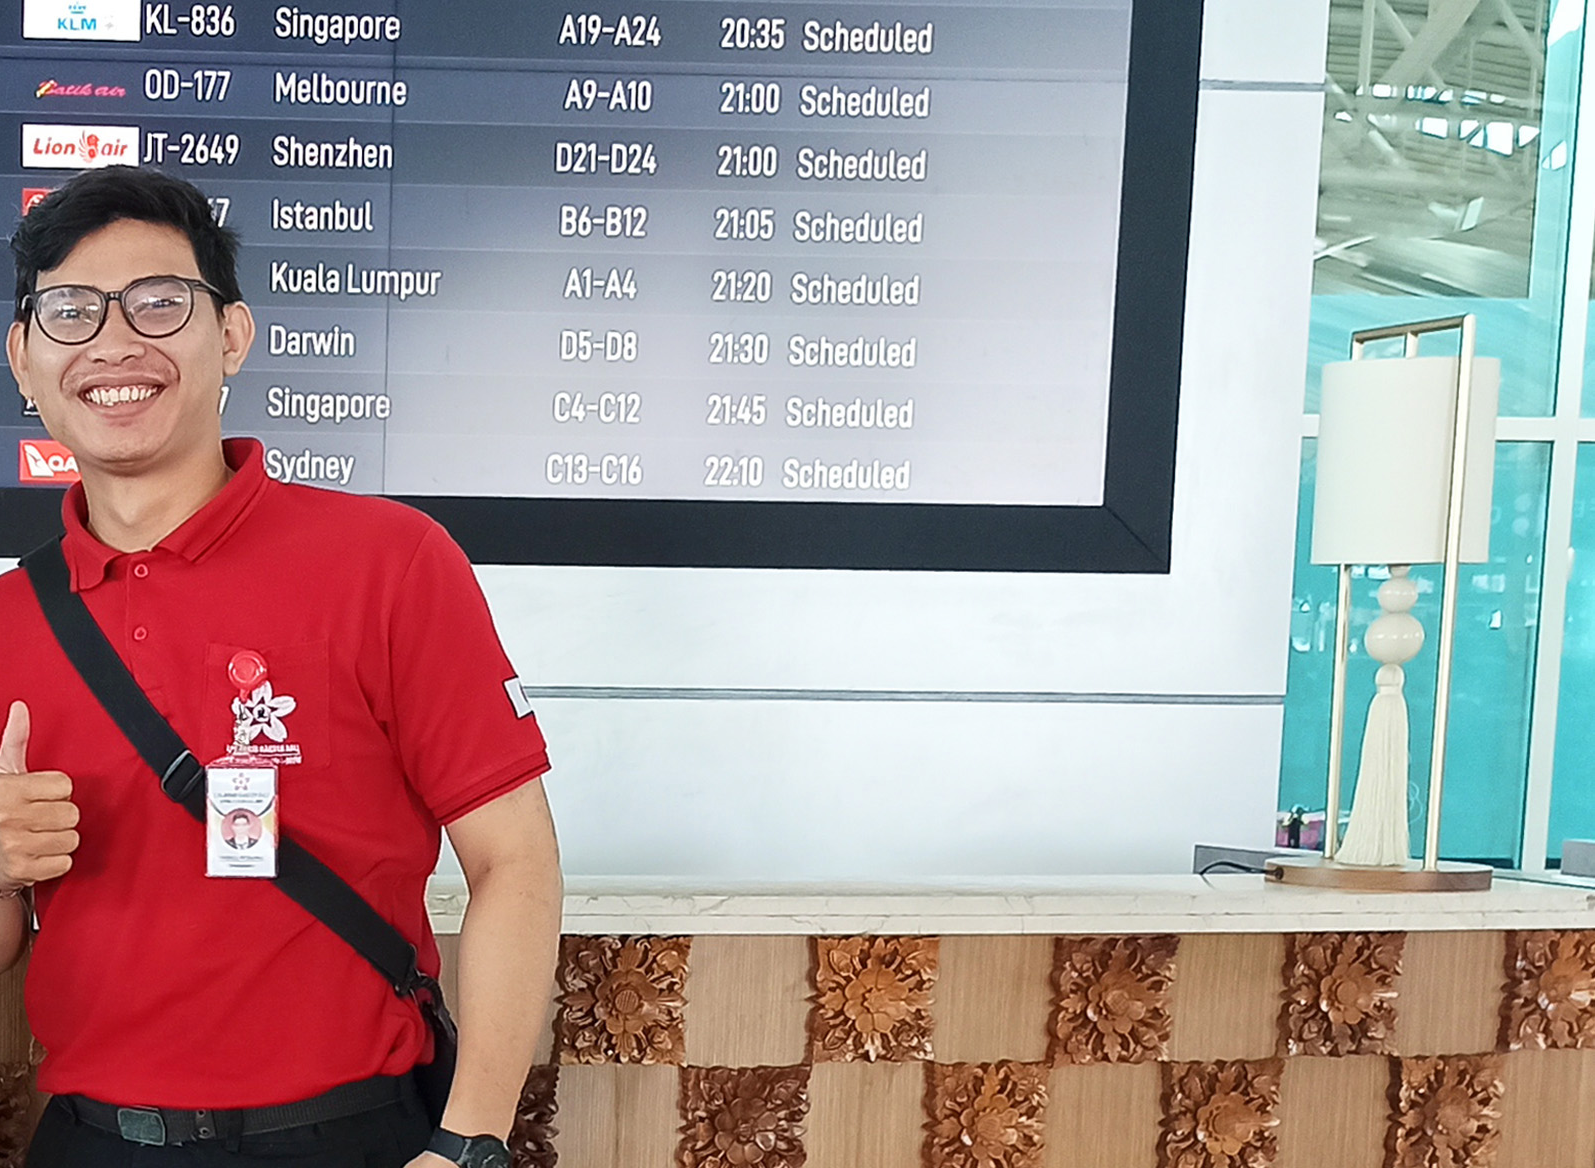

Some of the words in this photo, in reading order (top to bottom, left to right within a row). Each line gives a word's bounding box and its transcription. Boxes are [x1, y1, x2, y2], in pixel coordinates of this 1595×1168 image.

[57, 17, 97, 31] KLM
[145, 4, 235, 37] KL-836
[275, 7, 401, 45] Singapore
[558, 14, 662, 48] A19-A24
[721, 18, 786, 50] 20:35
[803, 20, 934, 55] Scheduled
[144, 69, 232, 101] OD-177
[275, 72, 407, 106] Melbourne
[563, 79, 653, 112] A9-A10
[719, 83, 781, 115] 21:00
[800, 85, 930, 119] Scheduled
[33, 137, 76, 155] Lion
[101, 139, 129, 157] air
[143, 132, 240, 166] JT-2649
[272, 136, 393, 169] Shenzhen
[555, 142, 658, 176] D21-D24
[717, 146, 778, 178] 21:00
[797, 148, 927, 182] Scheduled
[272, 199, 374, 231] Istanbul
[559, 205, 648, 239] B6-B12
[714, 208, 775, 241] 21:05
[793, 211, 924, 245] Scheduled
[270, 262, 340, 295] Kuala
[346, 265, 443, 301] Lumpur
[563, 267, 638, 301] A1-A4
[711, 270, 772, 303] 21:20
[790, 273, 921, 307] Scheduled
[269, 325, 355, 357] Darwin
[559, 330, 639, 363] D5-D8
[709, 333, 769, 365] 21:30
[788, 336, 917, 369] Scheduled
[267, 387, 392, 423] Singapore
[552, 392, 642, 424] C4-C12
[706, 395, 767, 426] 21:45
[785, 397, 915, 430] Scheduled
[266, 448, 355, 485] Sydney
[545, 453, 643, 487] C13-C16
[704, 456, 764, 488] 22:10
[782, 459, 911, 492] Scheduled
